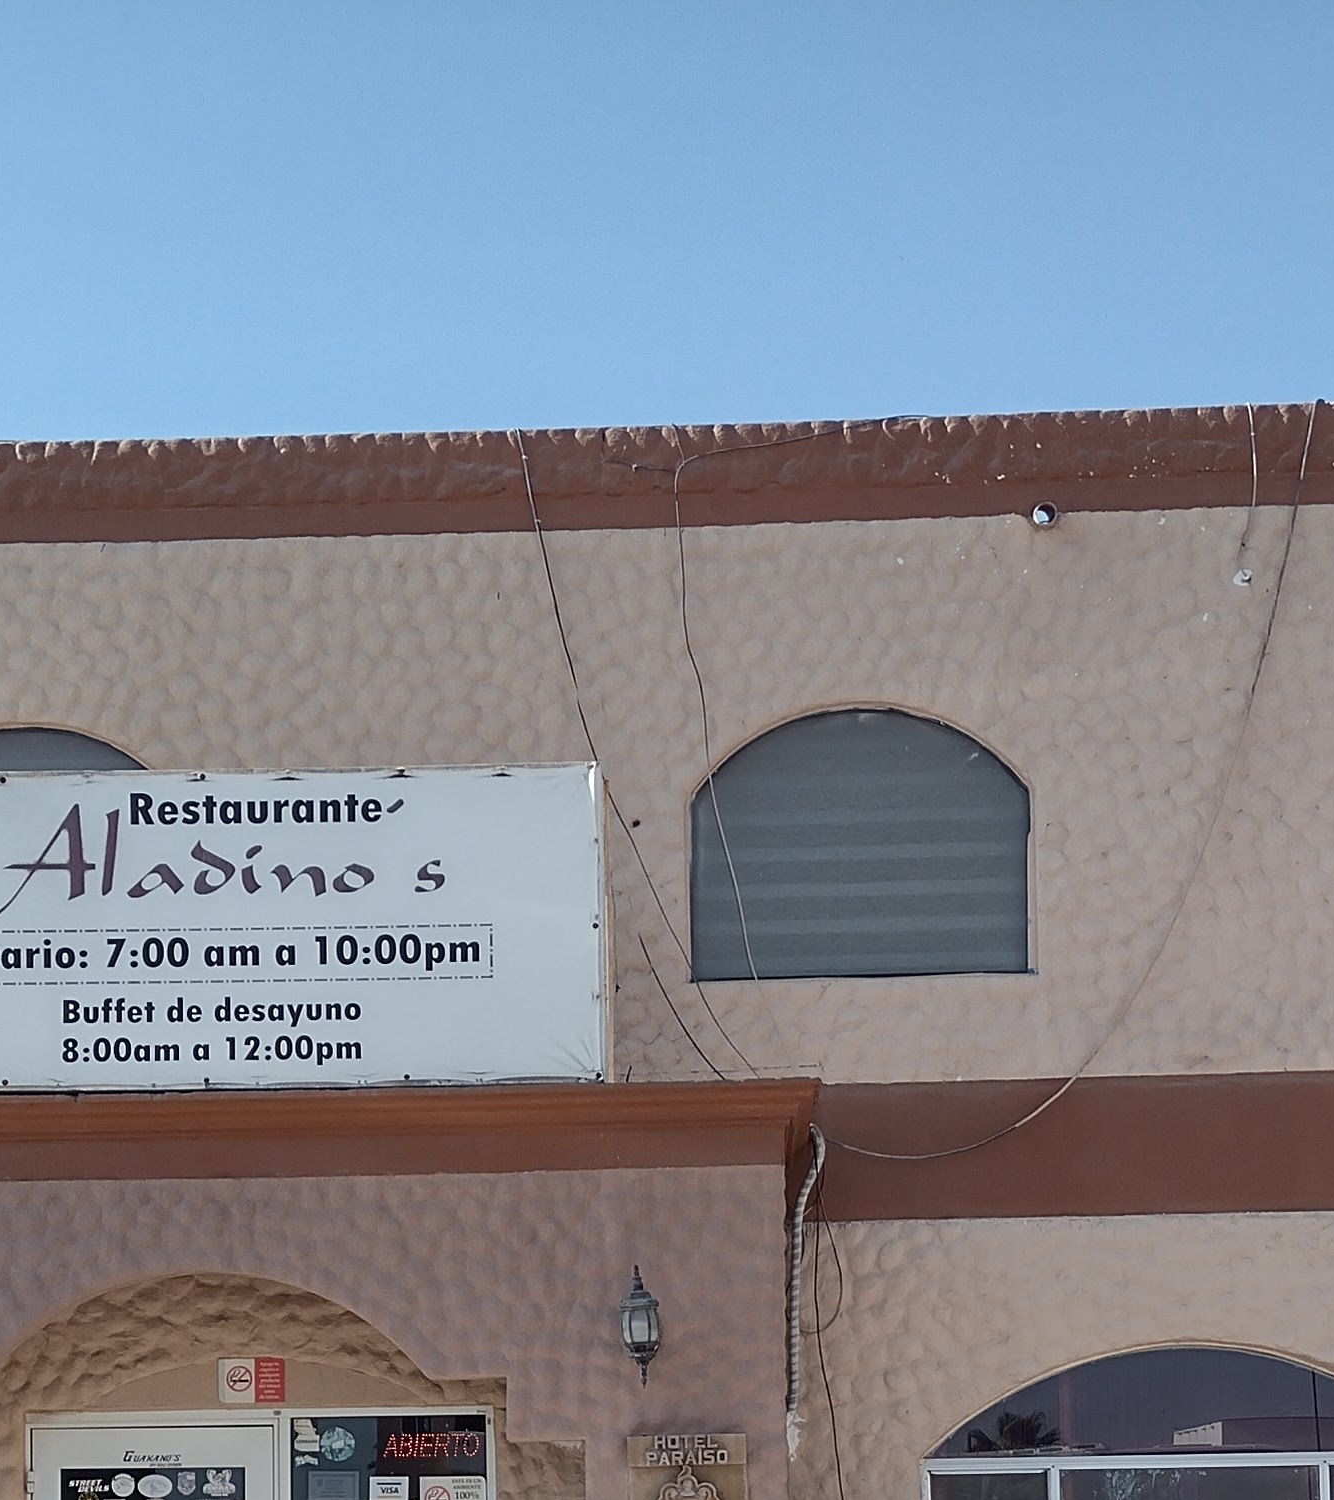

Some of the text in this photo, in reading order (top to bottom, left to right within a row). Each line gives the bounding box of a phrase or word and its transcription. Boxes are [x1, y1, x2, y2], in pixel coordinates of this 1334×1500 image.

[129, 793, 383, 825] Restaurante
[106, 937, 189, 968] 7:00
[204, 943, 260, 967] am
[275, 943, 296, 966] a
[315, 934, 480, 971] 10:00pm
[62, 996, 362, 1027] Buffet de desayuno
[62, 1035, 362, 1066] 8:00am a 12:00pm
[382, 1432, 480, 1459] ABIERTO
[654, 1435, 718, 1449] HOTEL
[380, 1486, 400, 1494] VISA
[455, 1491, 480, 1500] 100%
